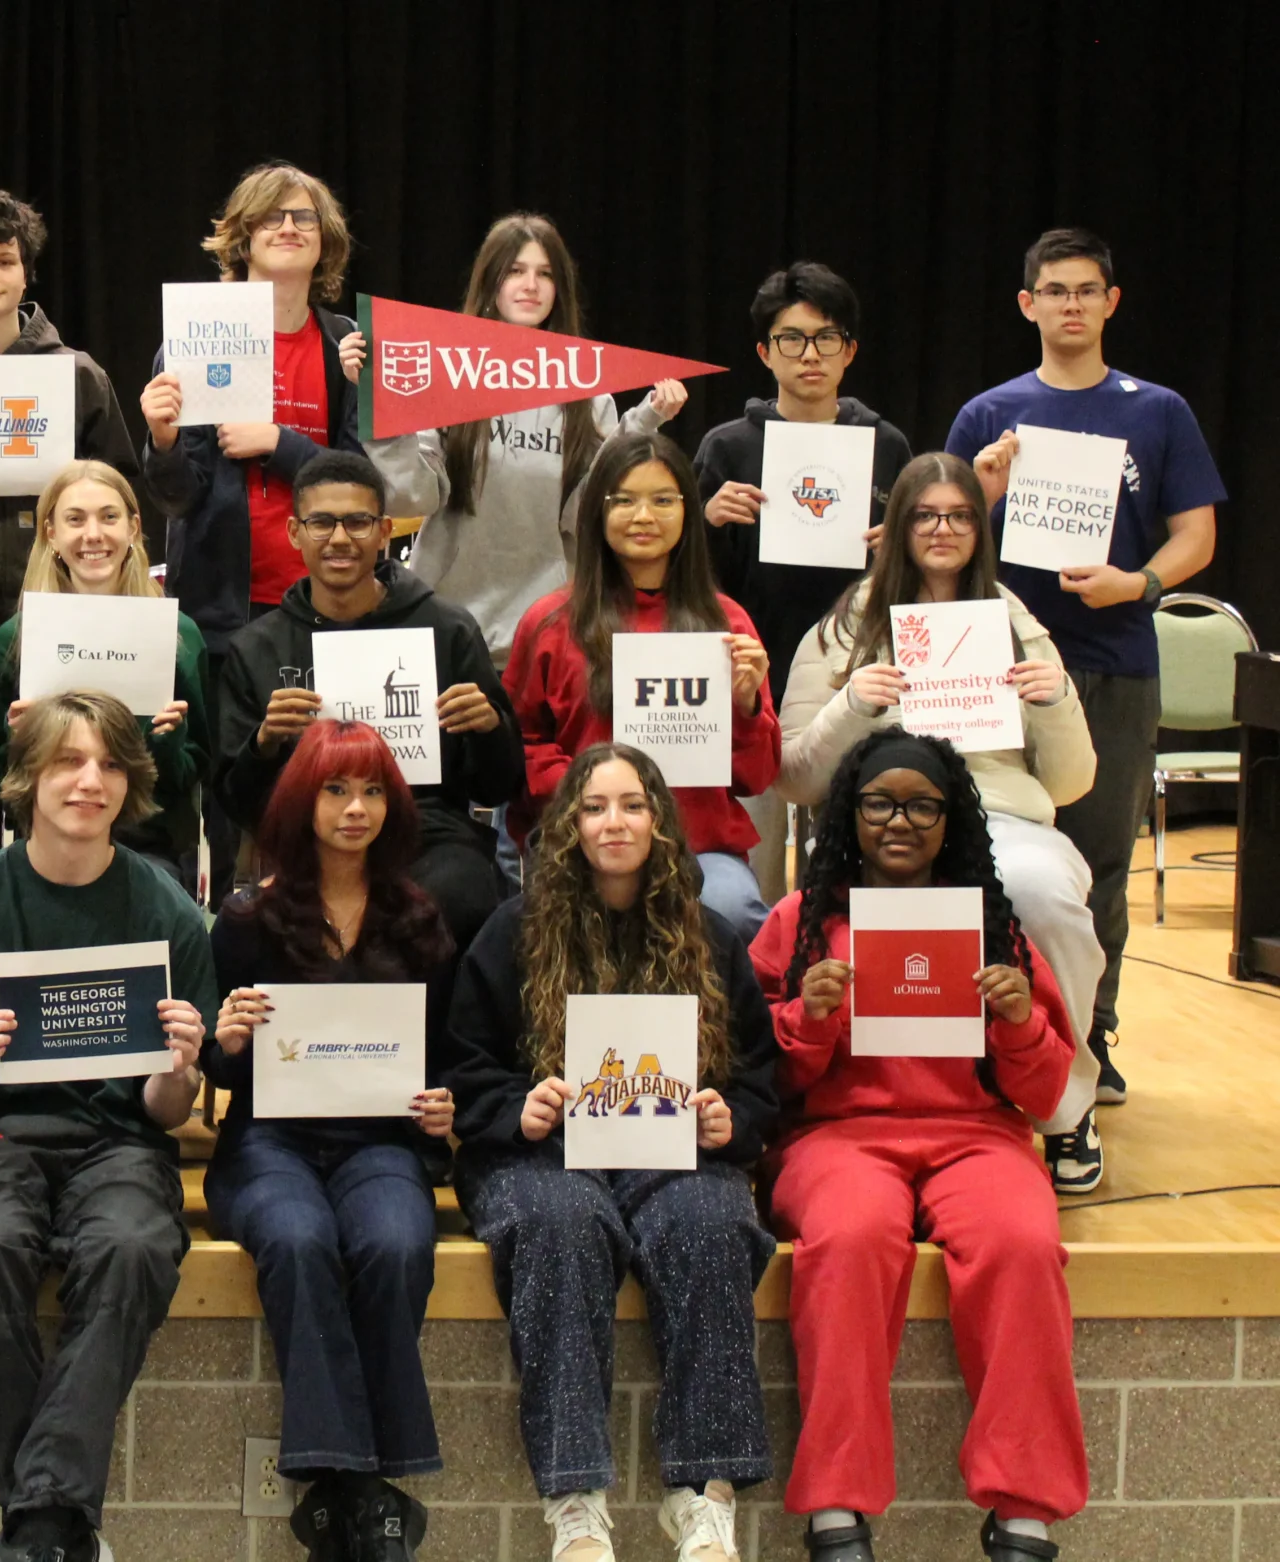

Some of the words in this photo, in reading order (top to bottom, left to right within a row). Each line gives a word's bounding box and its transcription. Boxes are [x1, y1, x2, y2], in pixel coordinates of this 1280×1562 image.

[168, 338, 271, 357] UNIVERSITY
[435, 346, 605, 390] WashU
[797, 487, 840, 502] UTSA
[1017, 477, 1062, 492] UNITED
[1066, 485, 1110, 499] STATES
[1009, 491, 1039, 509] AIR
[1046, 497, 1114, 521] FORCE
[1010, 511, 1108, 538] ACADEMY
[907, 674, 993, 692] niversity
[635, 677, 710, 707] FIU
[903, 693, 995, 713] groningen
[647, 712, 698, 722] FLORIDA
[906, 720, 962, 731] university
[964, 718, 1004, 729] college
[624, 723, 721, 733] INTERNATIONAL
[637, 735, 709, 744] UNIVERSITY
[41, 991, 67, 1003] THE
[70, 986, 126, 1001] GEORGE
[893, 984, 941, 995] uOttawa
[41, 1001, 126, 1016] WASHINGTON
[41, 1014, 126, 1030] UNIVERSITY
[113, 1034, 128, 1043] DC
[307, 1043, 401, 1053] EMBRY-RIDDLE
[607, 1075, 692, 1110] UALBANY
